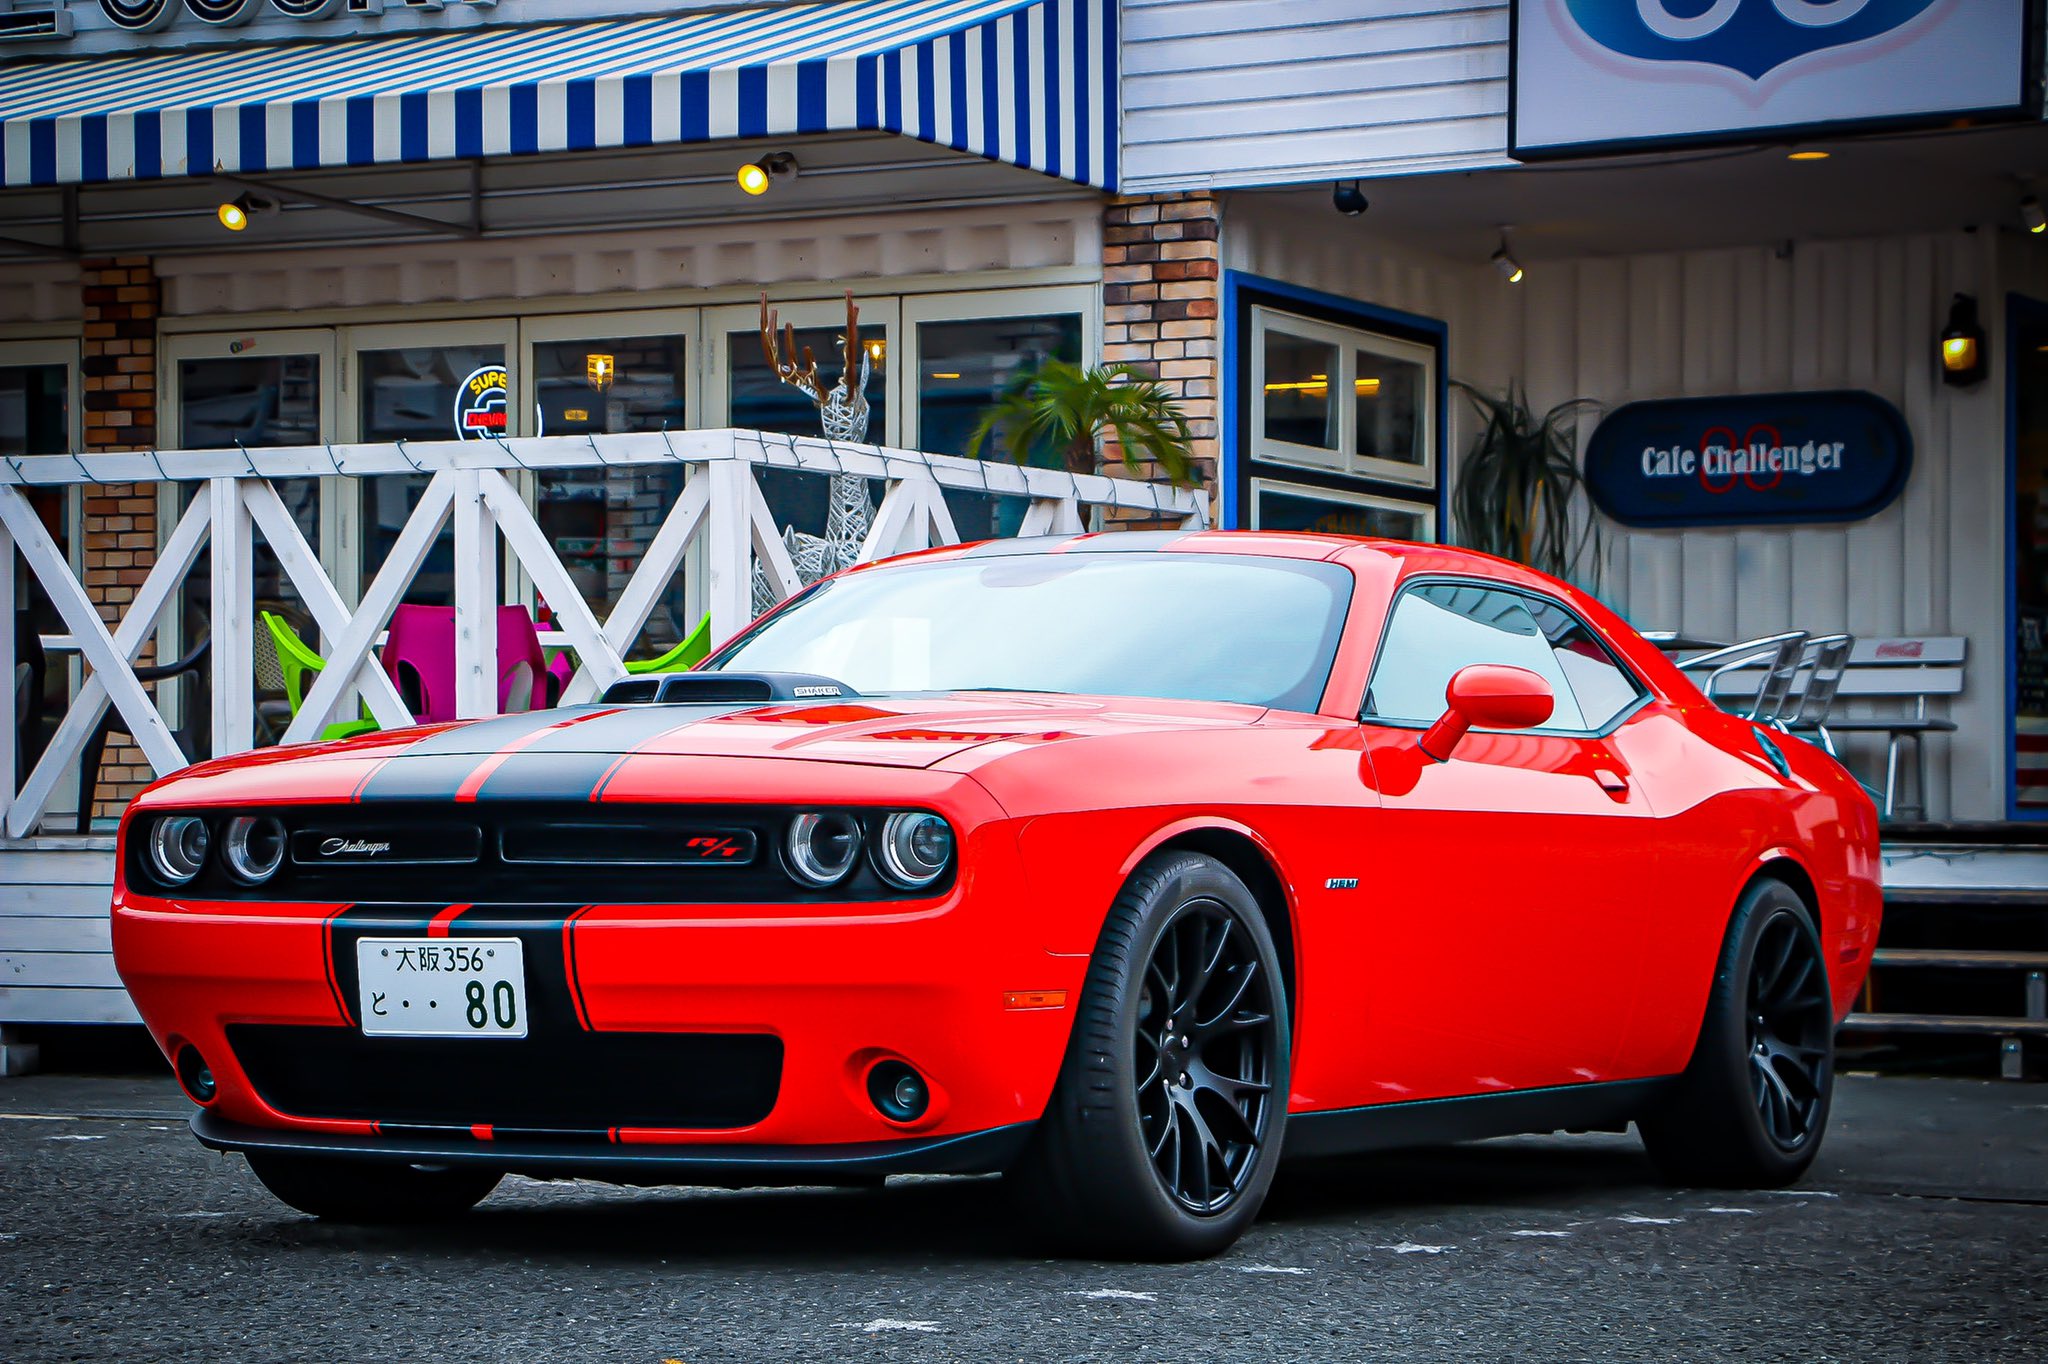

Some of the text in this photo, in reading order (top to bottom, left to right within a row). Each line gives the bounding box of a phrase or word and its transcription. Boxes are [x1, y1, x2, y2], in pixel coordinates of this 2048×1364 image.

[1642, 440, 1845, 476] Cafe Challenger
[794, 686, 842, 698] SHAKER
[320, 837, 390, 856] Challenger
[687, 837, 743, 857] R/T
